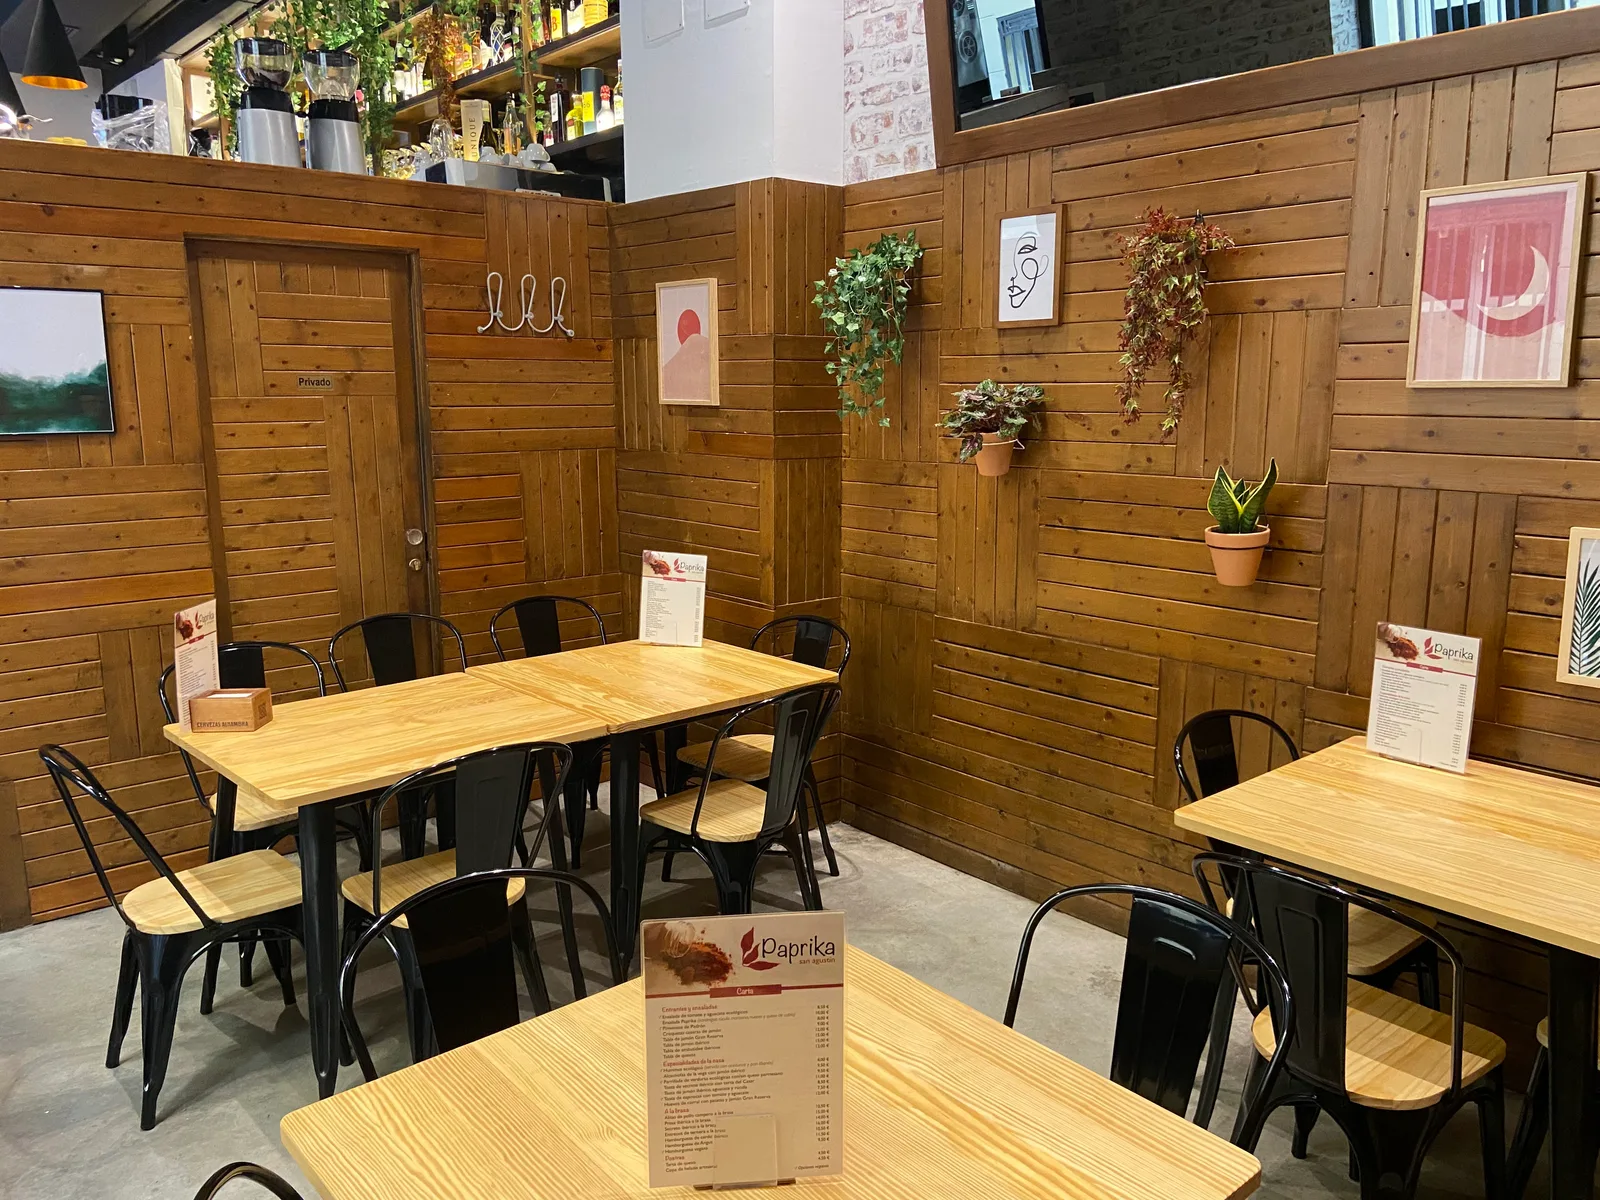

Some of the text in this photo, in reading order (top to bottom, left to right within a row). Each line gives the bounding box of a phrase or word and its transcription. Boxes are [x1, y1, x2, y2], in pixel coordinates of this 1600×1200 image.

[469, 118, 478, 157] UNIQUE
[298, 378, 331, 386] Privado
[1434, 643, 1474, 660] Paprika
[762, 936, 835, 964] Paprika
